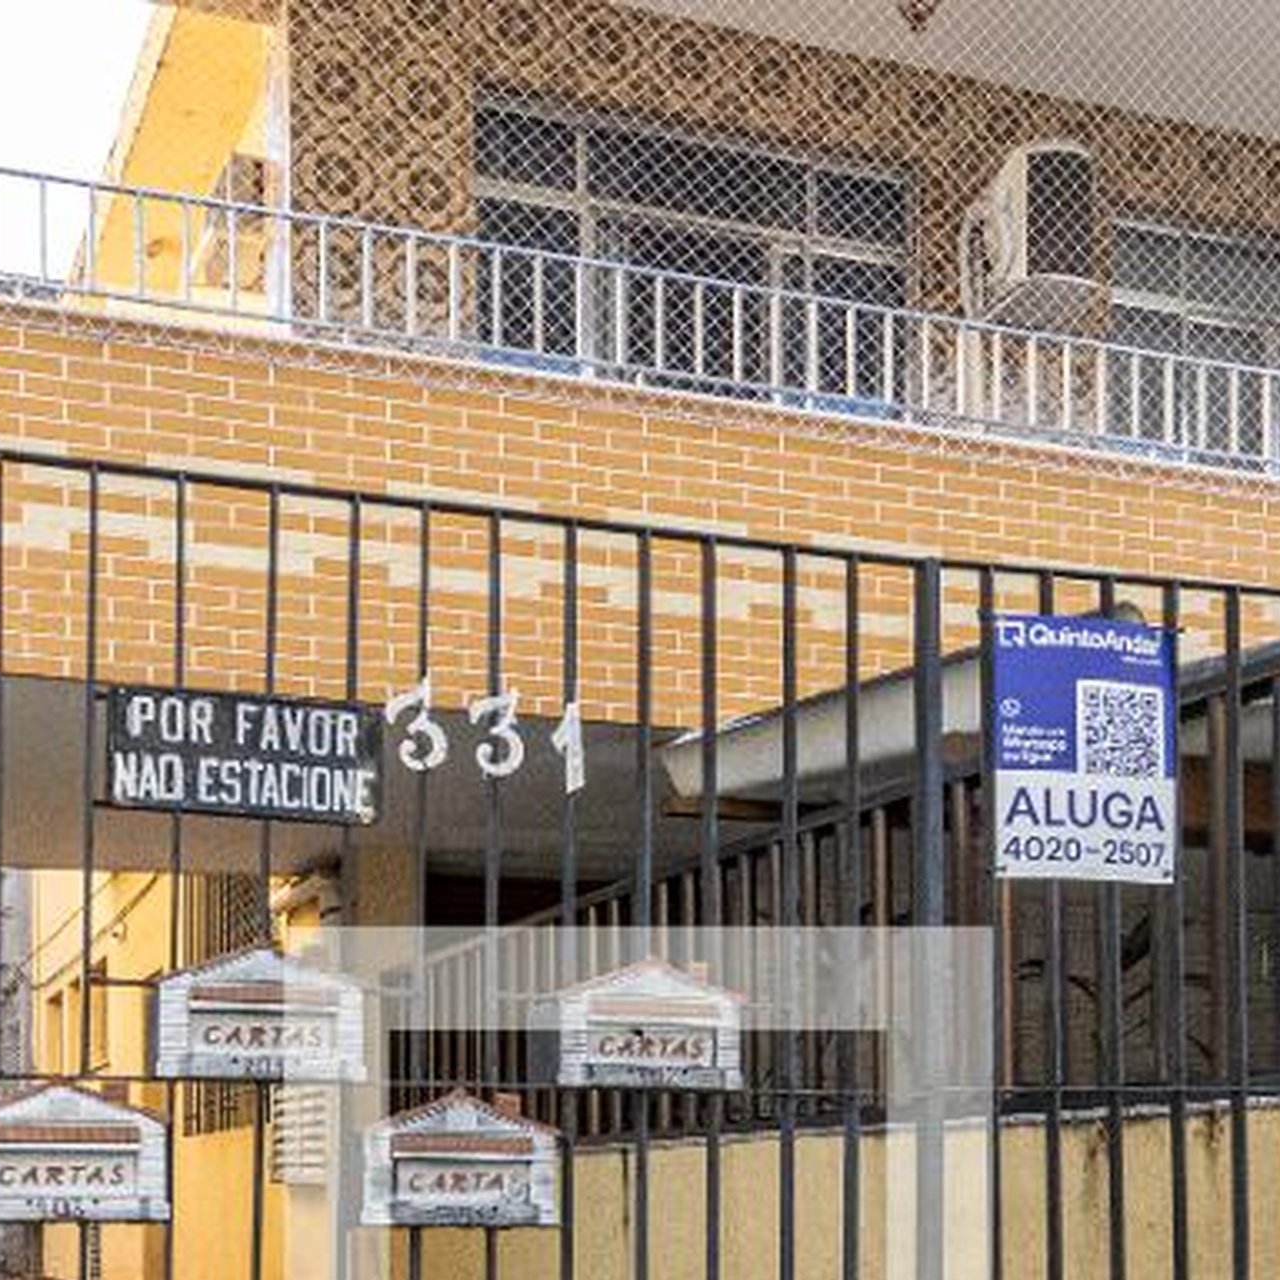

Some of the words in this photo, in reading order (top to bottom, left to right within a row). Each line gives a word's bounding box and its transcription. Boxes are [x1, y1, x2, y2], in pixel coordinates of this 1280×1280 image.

[1028, 624, 1162, 655] QuintoAndar
[126, 695, 214, 745] POR
[236, 702, 359, 758] FAVOR
[386, 677, 585, 794] 331
[196, 757, 376, 813] ESTACIONE
[1004, 786, 1165, 832] ALUGA
[1003, 836, 1166, 868] 4020-2507
[202, 1025, 322, 1048] CARTAS
[598, 1033, 705, 1059] CARTAS
[408, 1172, 525, 1195] CARTA
